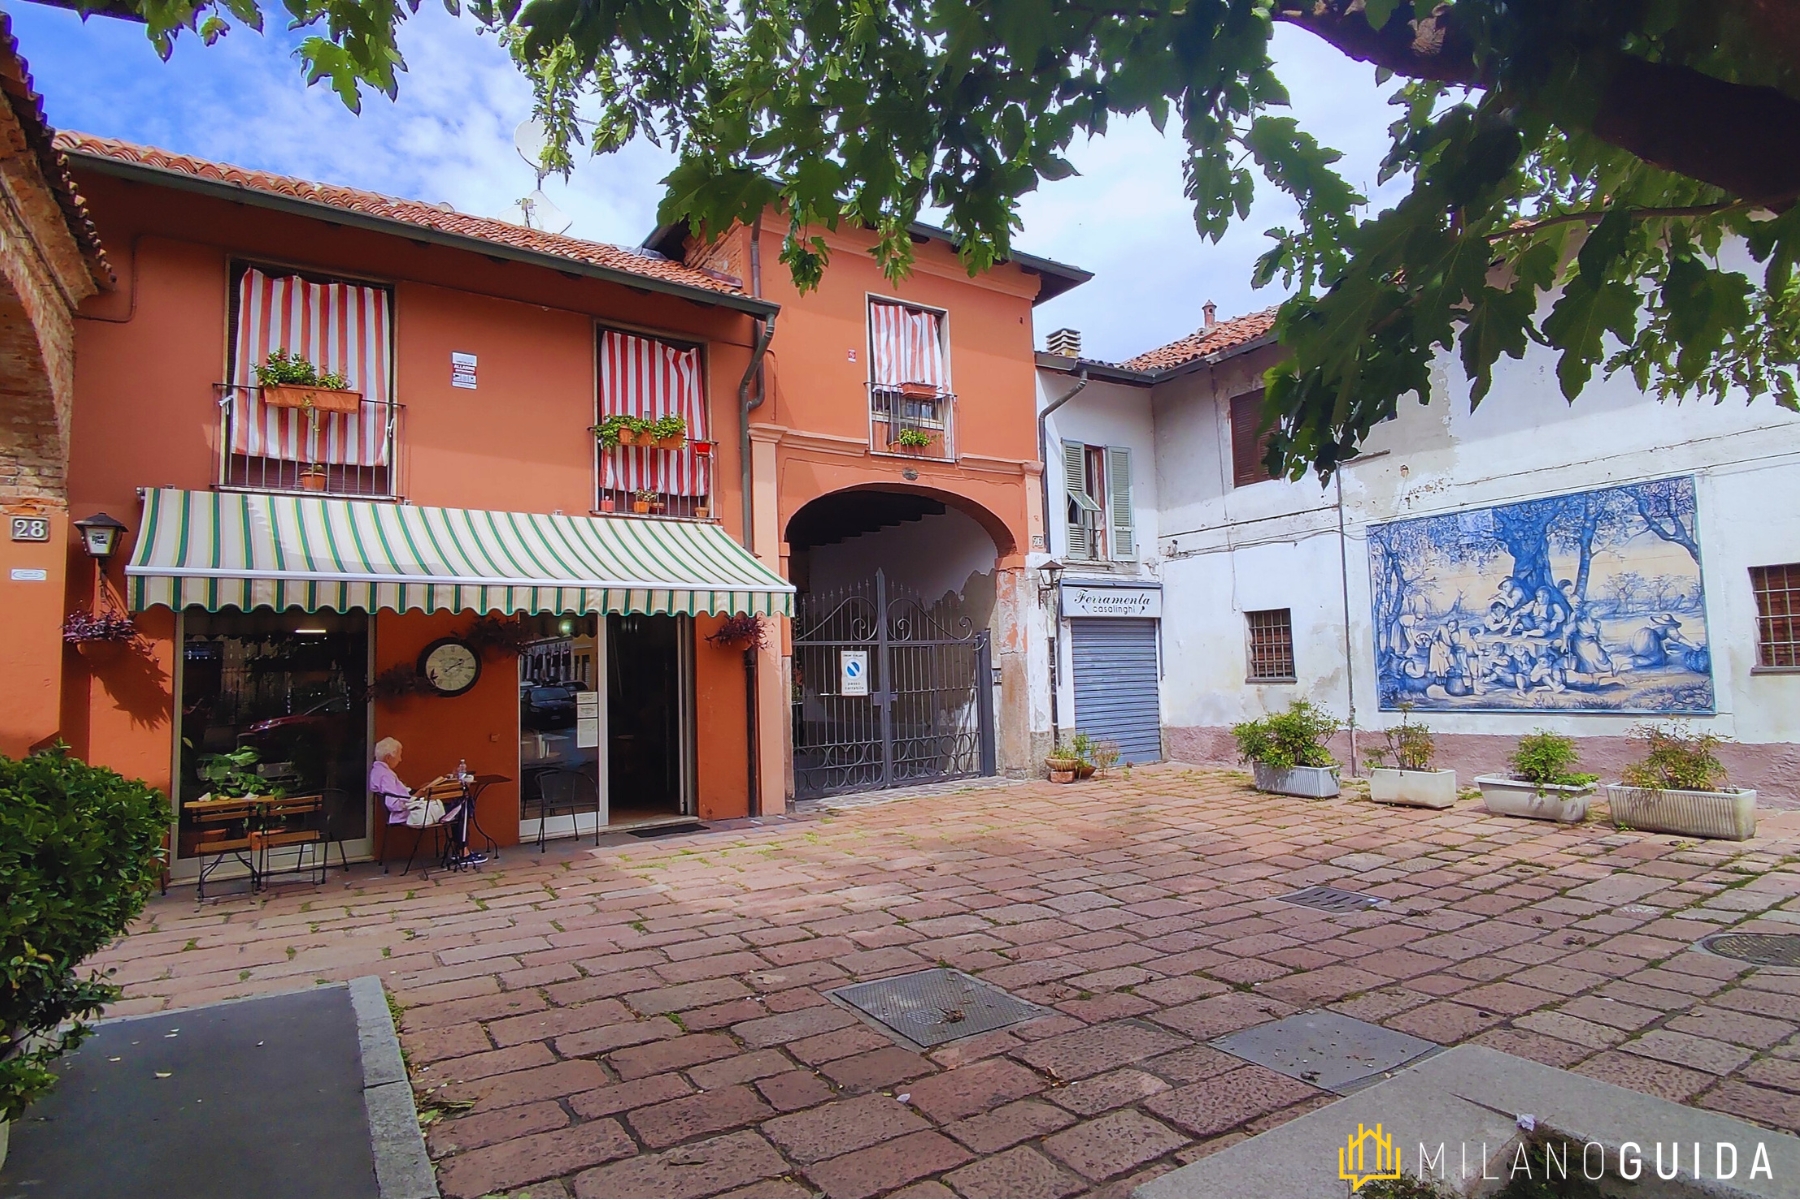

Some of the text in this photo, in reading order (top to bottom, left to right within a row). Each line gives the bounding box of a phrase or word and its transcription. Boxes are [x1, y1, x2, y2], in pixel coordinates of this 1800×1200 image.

[14, 519, 45, 538] 28
[1073, 588, 1151, 605] Ferramenta
[1092, 605, 1136, 615] casalinghi
